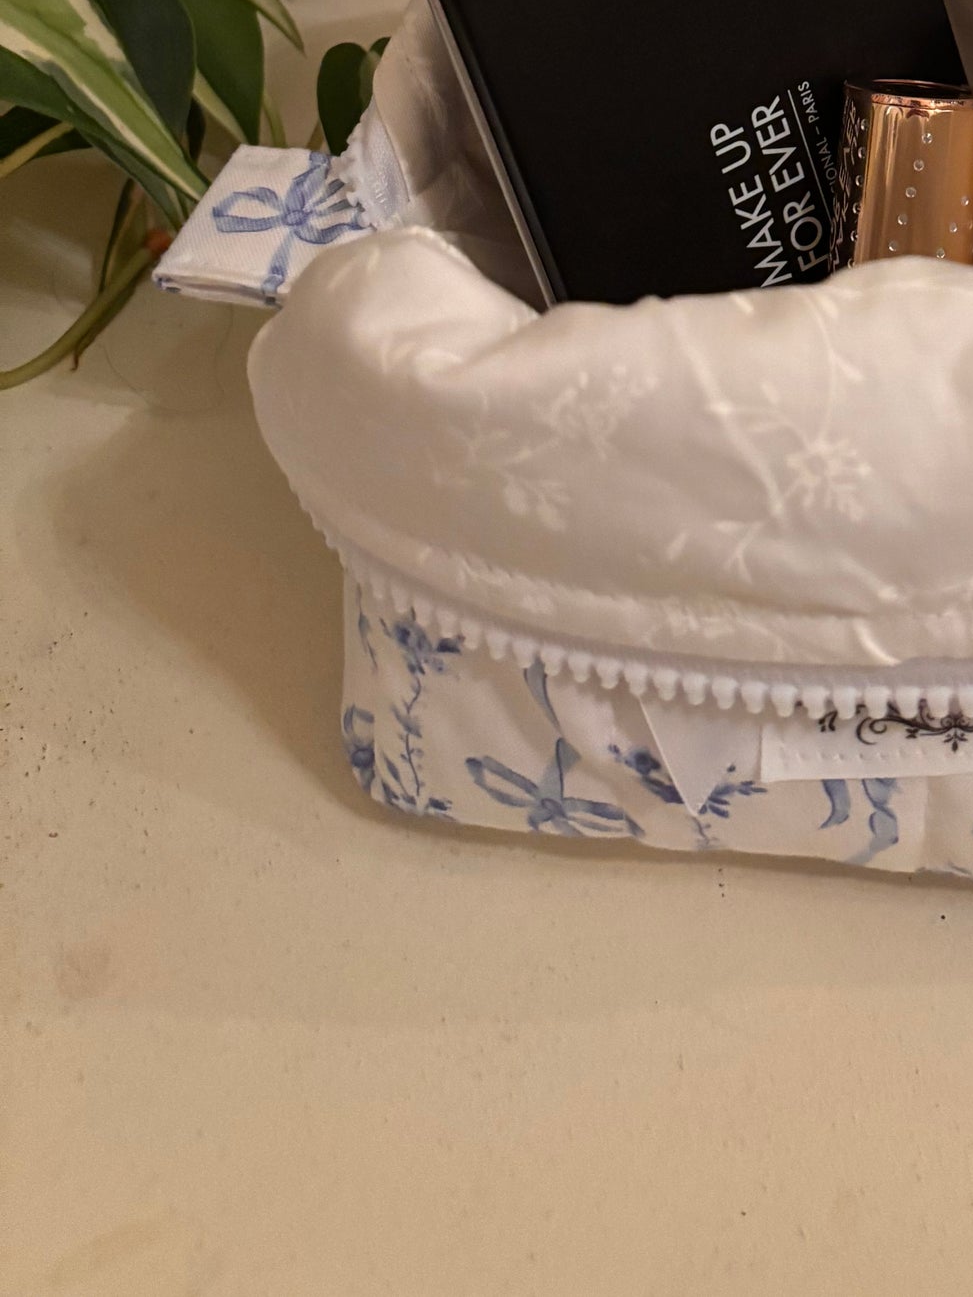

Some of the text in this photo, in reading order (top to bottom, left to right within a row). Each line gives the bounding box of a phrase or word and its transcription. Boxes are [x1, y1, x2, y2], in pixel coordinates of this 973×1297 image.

[751, 95, 830, 272] FOR EVER
[798, 81, 820, 123] PARIS
[710, 123, 793, 288] MAKE UP
